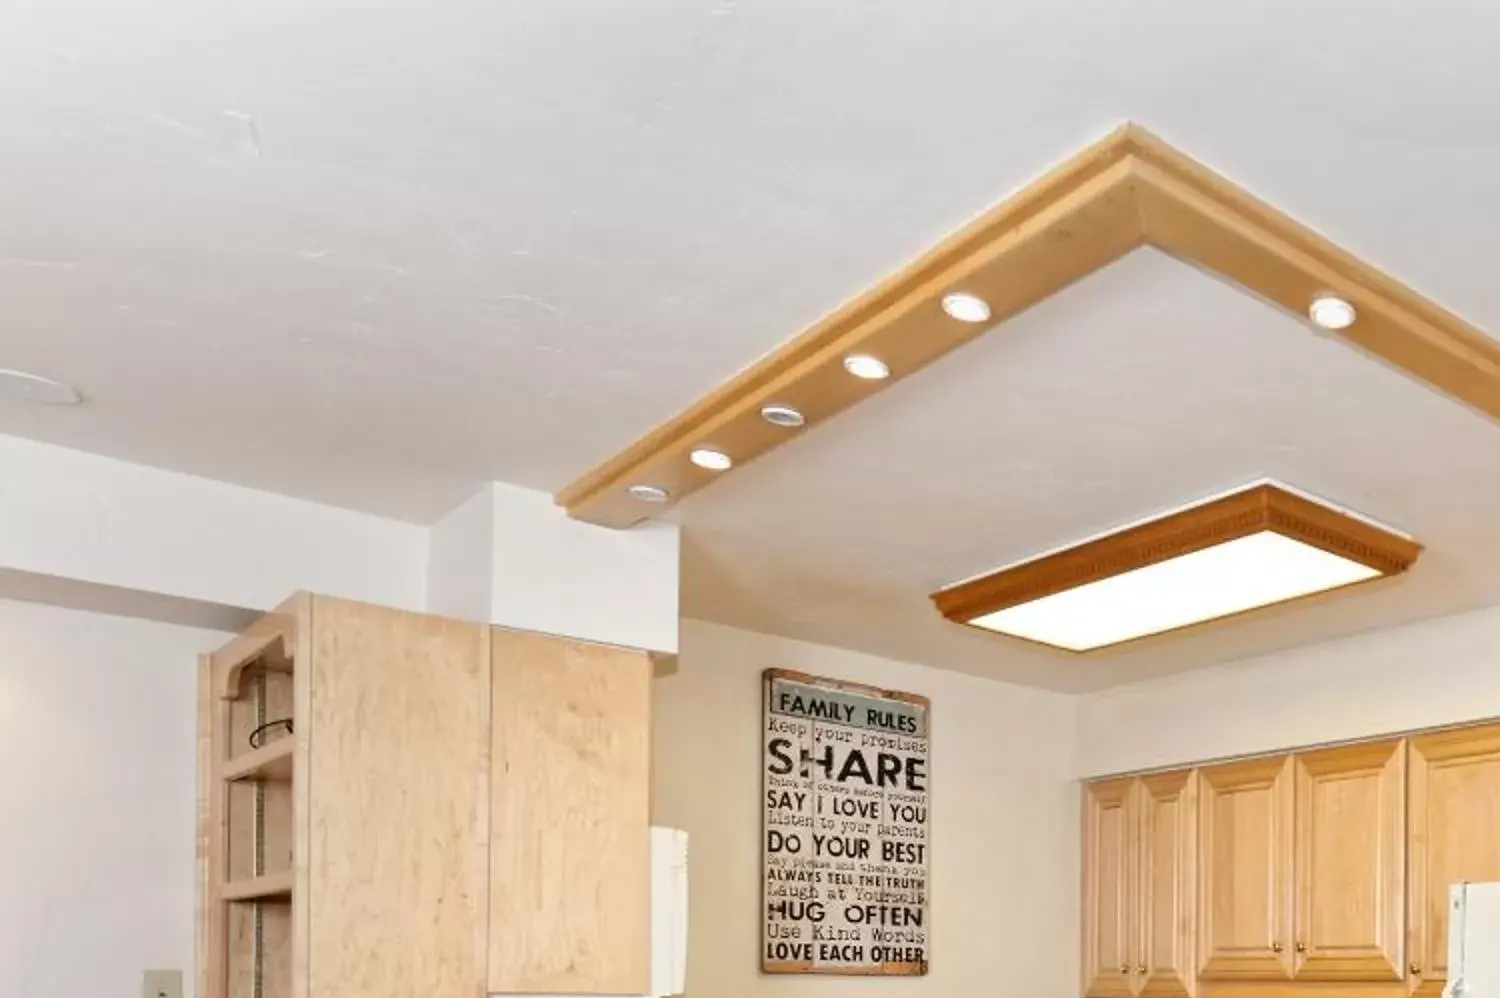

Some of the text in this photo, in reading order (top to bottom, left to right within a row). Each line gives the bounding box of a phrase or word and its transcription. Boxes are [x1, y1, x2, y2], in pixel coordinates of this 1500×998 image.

[780, 693, 917, 733] FAMILY RULES
[768, 717, 927, 753] Keep your promises
[768, 738, 926, 791] SHARE
[767, 789, 926, 824] SAY I LOVE YOU
[768, 810, 925, 838] Listen to your parents
[812, 834, 870, 859] YOUR
[882, 840, 925, 864] BEST
[767, 868, 925, 889] ALWAYS TELL THE TRUTH
[767, 882, 819, 900] Laugh
[827, 889, 846, 901] at
[767, 900, 923, 926] HUG OFTEN
[767, 923, 925, 944] Use Kind Words
[767, 943, 924, 963] LOVE EACH OTHER
